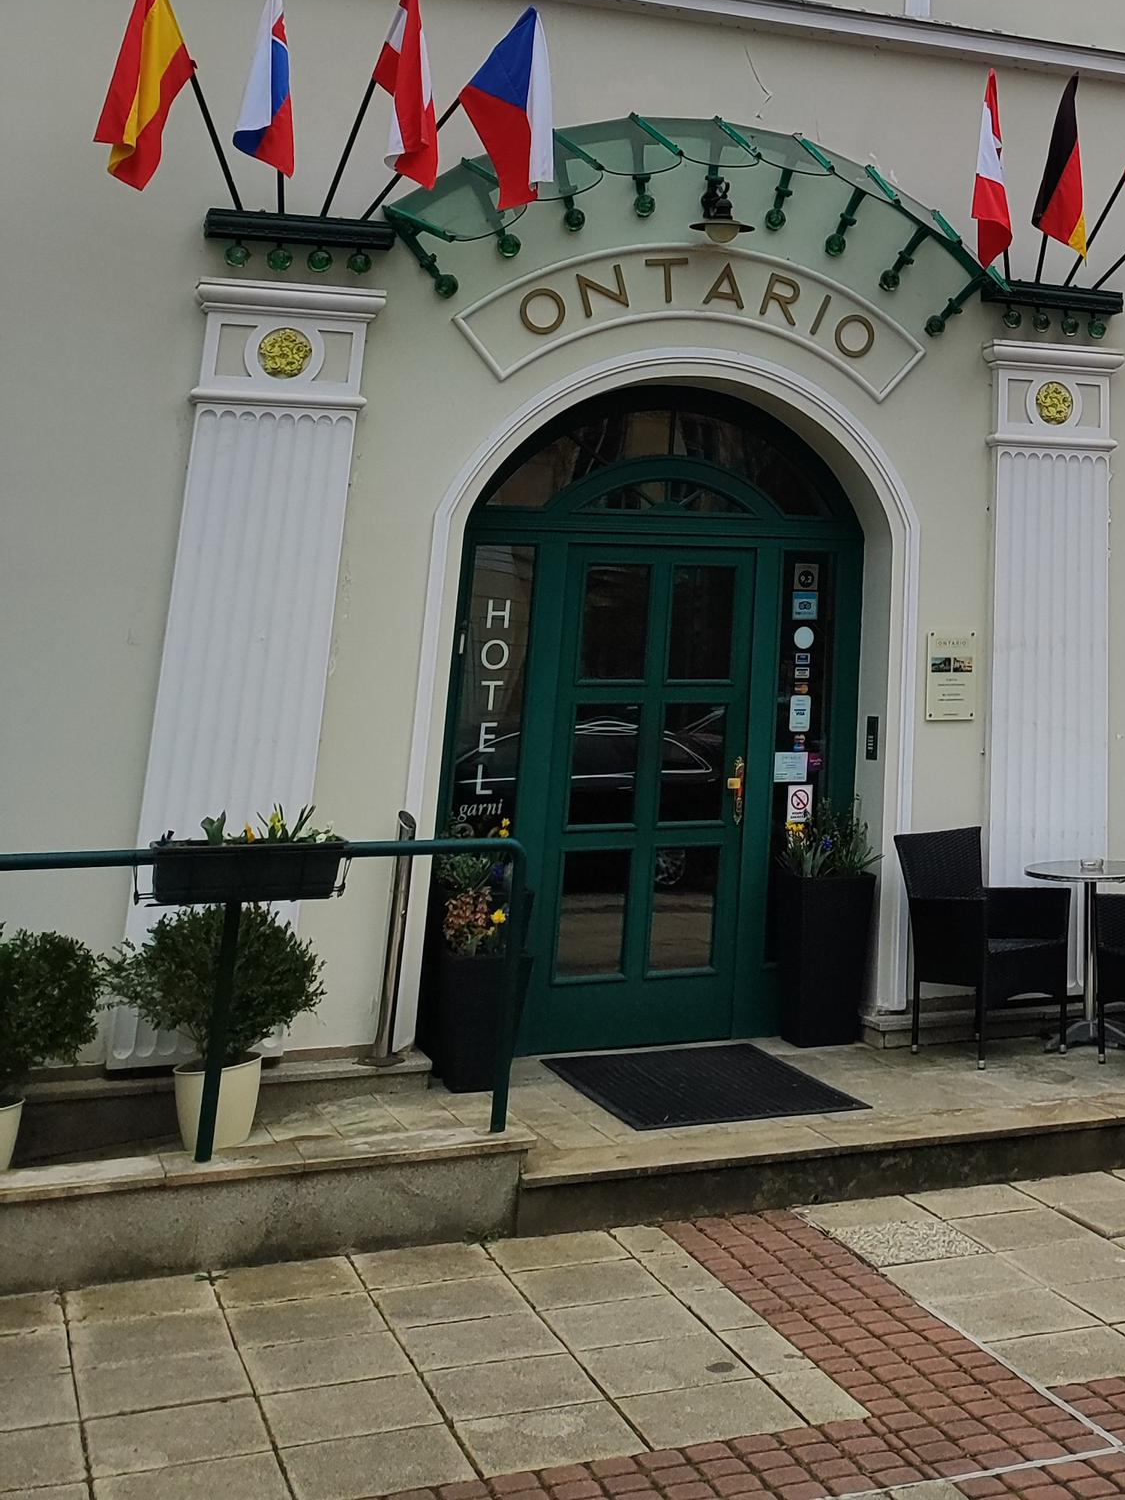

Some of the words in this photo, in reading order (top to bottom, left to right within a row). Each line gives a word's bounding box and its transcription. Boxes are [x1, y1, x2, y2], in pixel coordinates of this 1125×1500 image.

[518, 256, 876, 359] ONTARIO
[475, 599, 512, 795] HOTEL
[457, 799, 504, 823] garni
